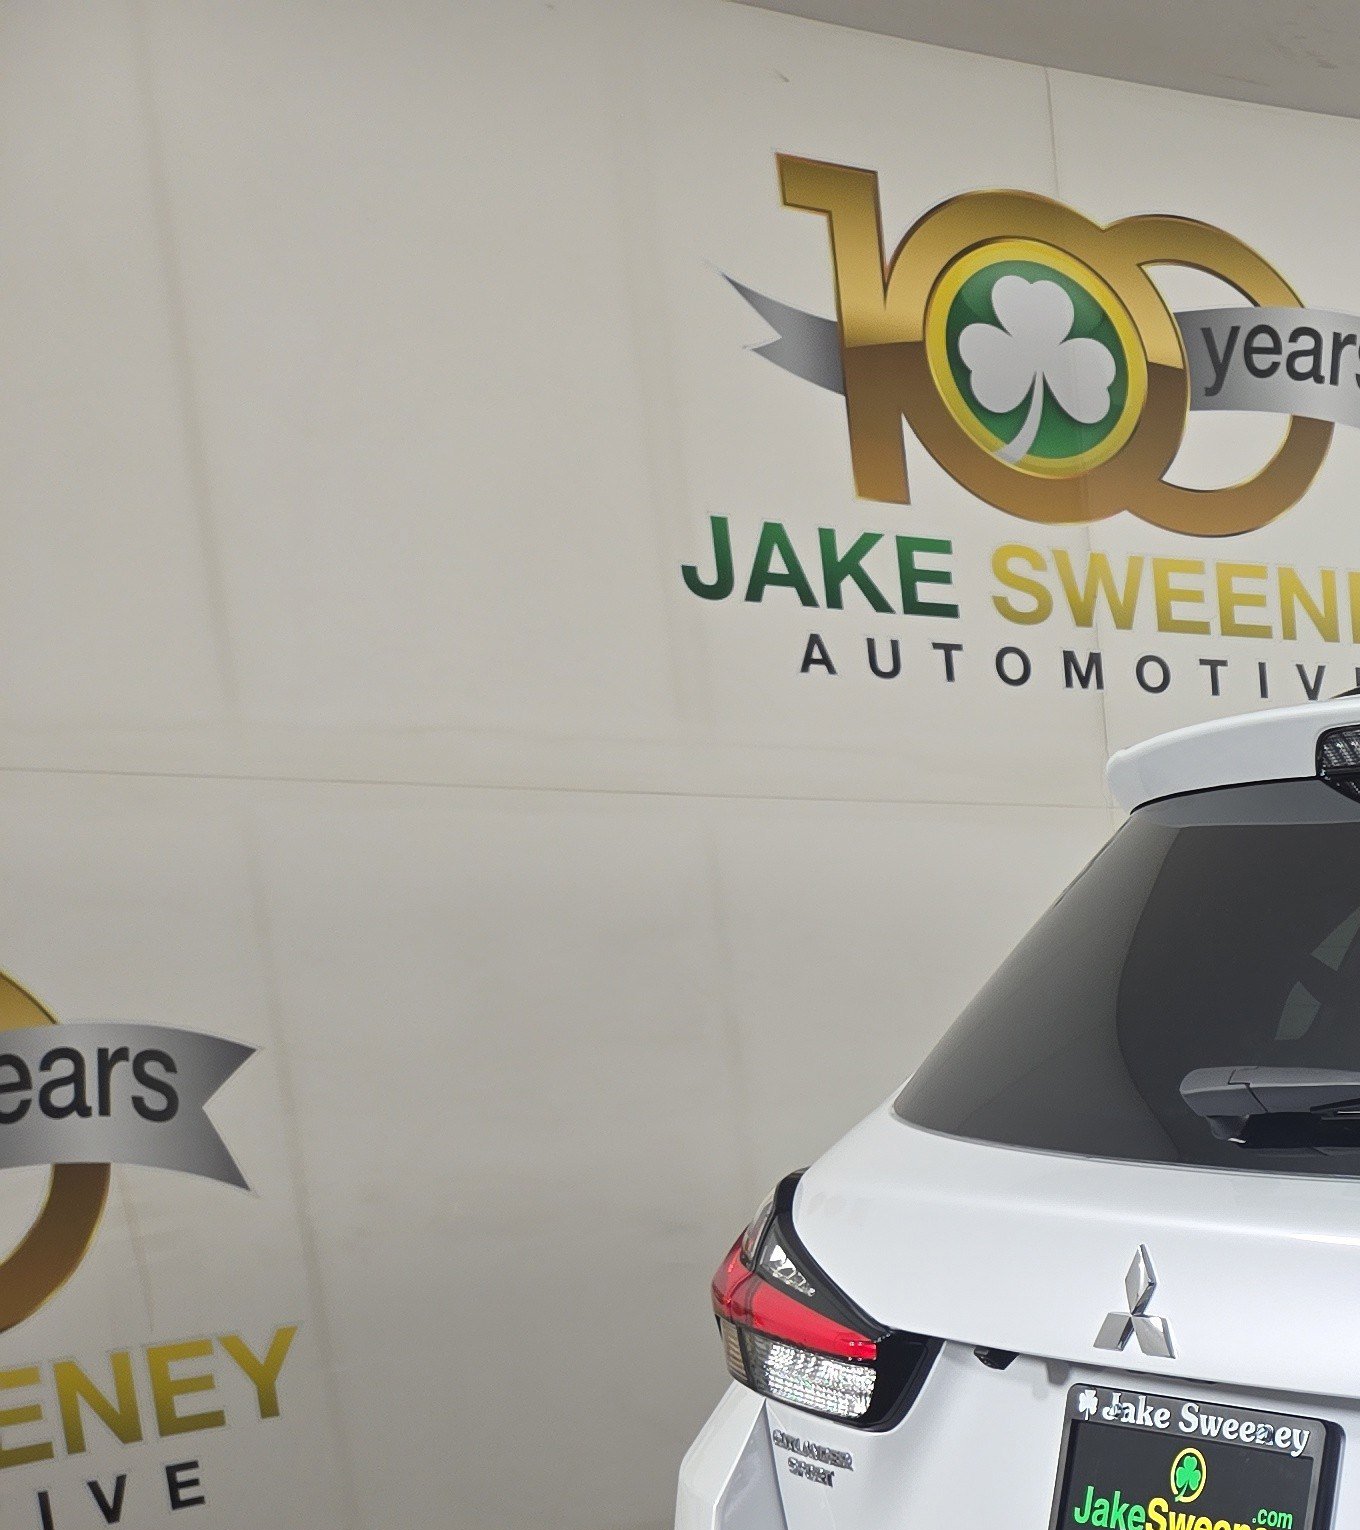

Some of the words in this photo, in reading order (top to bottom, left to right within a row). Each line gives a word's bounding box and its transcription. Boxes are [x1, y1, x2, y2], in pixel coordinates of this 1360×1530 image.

[681, 515, 960, 620] JAKE
[1102, 1392, 1171, 1429] Jake
[1178, 1402, 1310, 1457] Sweeney
